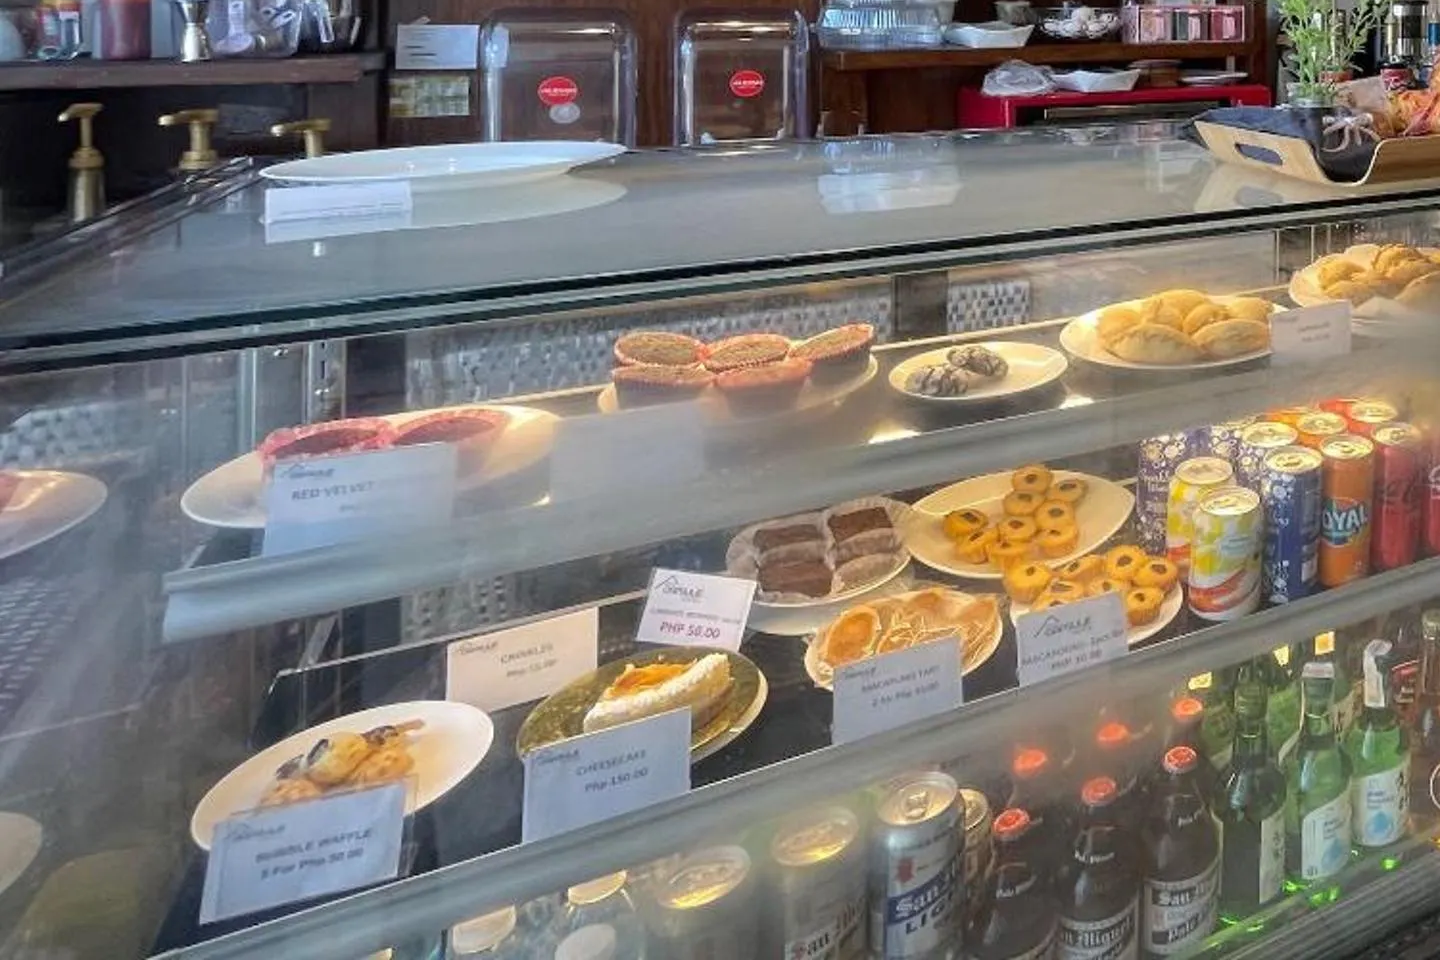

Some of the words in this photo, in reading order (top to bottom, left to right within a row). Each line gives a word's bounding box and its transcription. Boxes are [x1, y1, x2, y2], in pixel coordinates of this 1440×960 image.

[291, 487, 320, 501] RED
[322, 480, 376, 498] VELVET
[575, 748, 647, 777] CHEESECAKE
